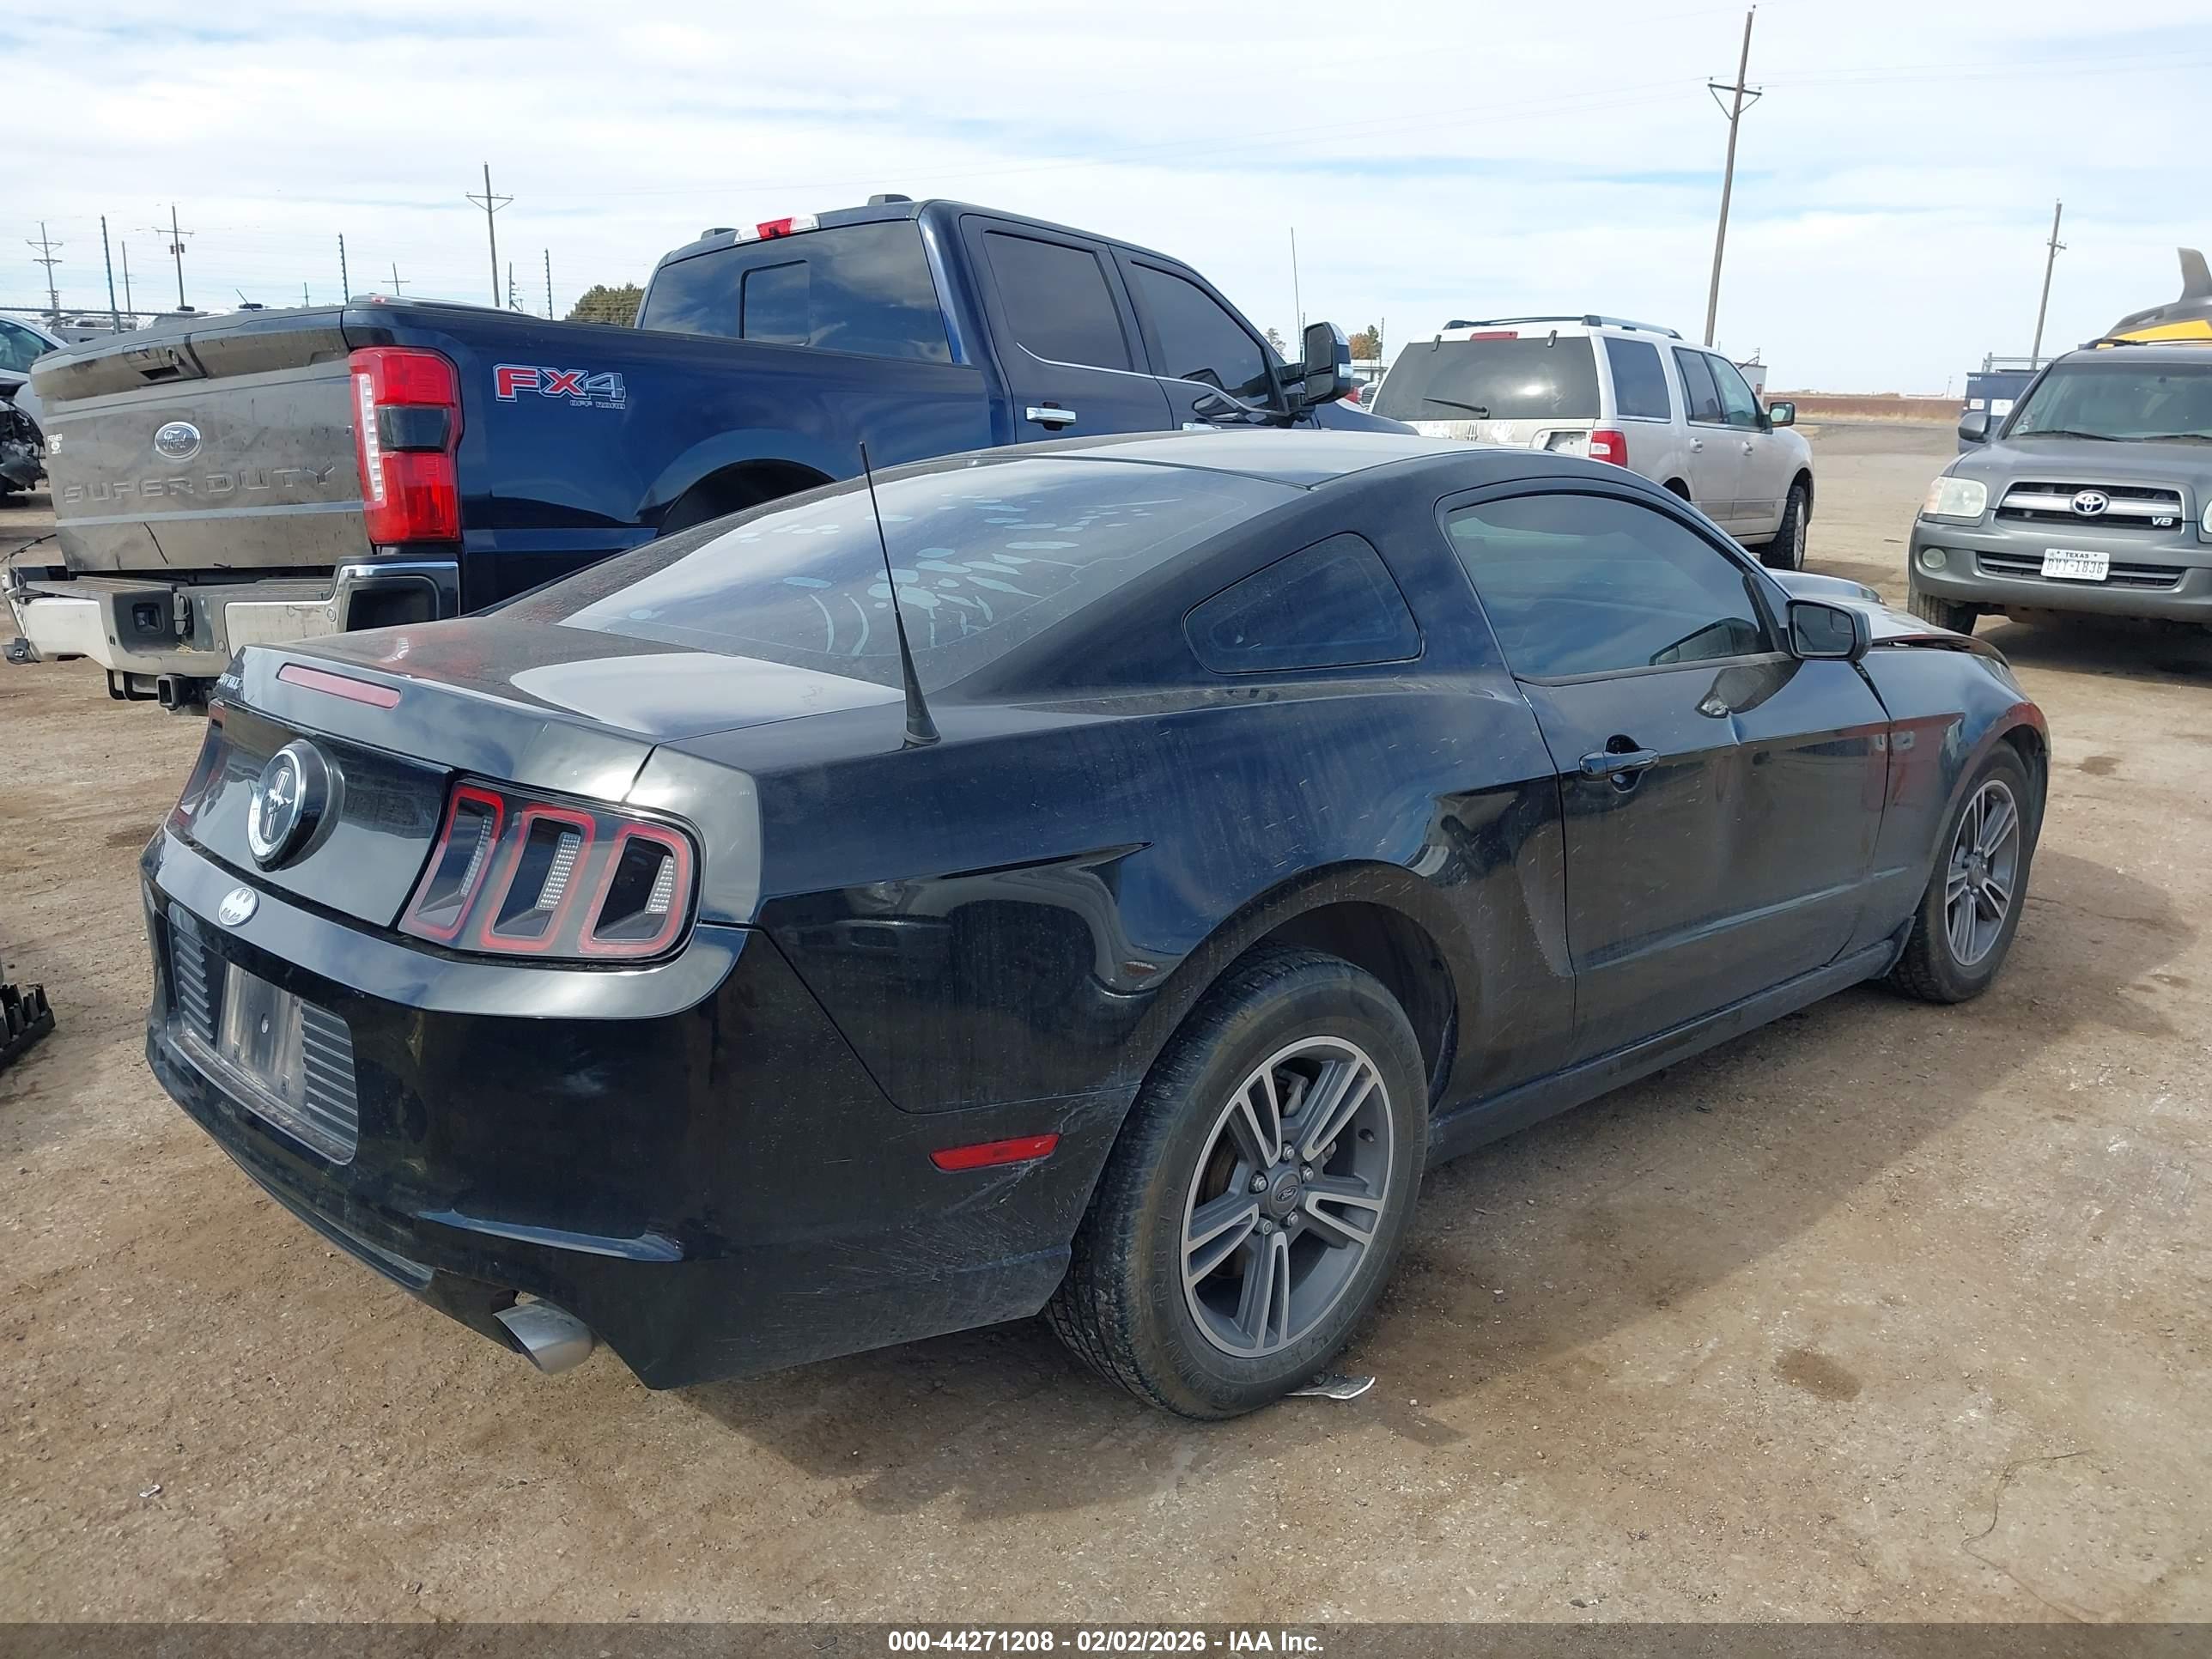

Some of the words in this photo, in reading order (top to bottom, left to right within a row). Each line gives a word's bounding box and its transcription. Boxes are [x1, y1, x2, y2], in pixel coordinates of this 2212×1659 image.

[493, 363, 626, 403] FX4
[63, 476, 195, 504] SUPER
[204, 466, 337, 494] DUTY
[2151, 516, 2173, 526] V8
